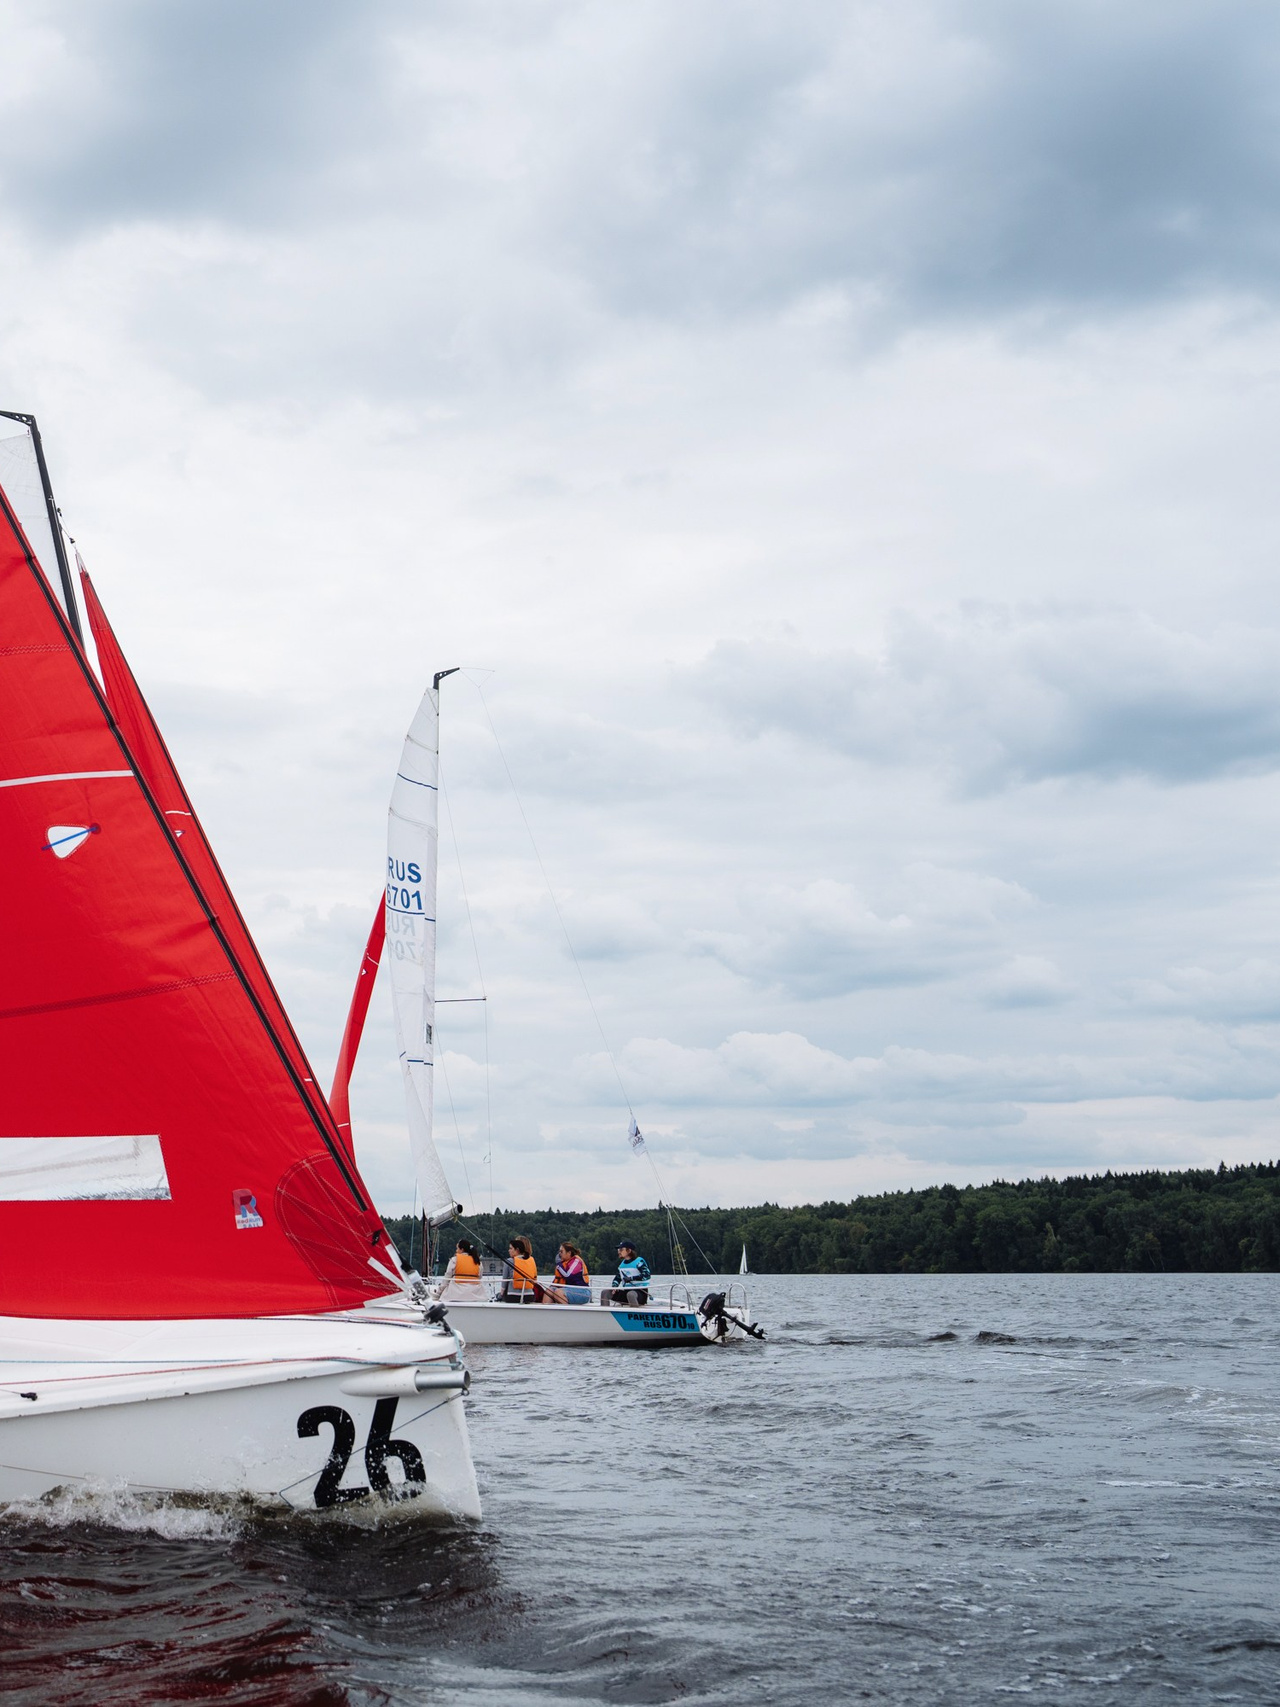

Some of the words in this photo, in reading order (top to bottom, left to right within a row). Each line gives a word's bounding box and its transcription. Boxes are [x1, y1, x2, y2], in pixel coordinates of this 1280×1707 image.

[387, 855, 422, 884] RUS
[386, 882, 423, 910] 6701
[660, 1314, 687, 1329] 670
[296, 1396, 427, 1508] 26
